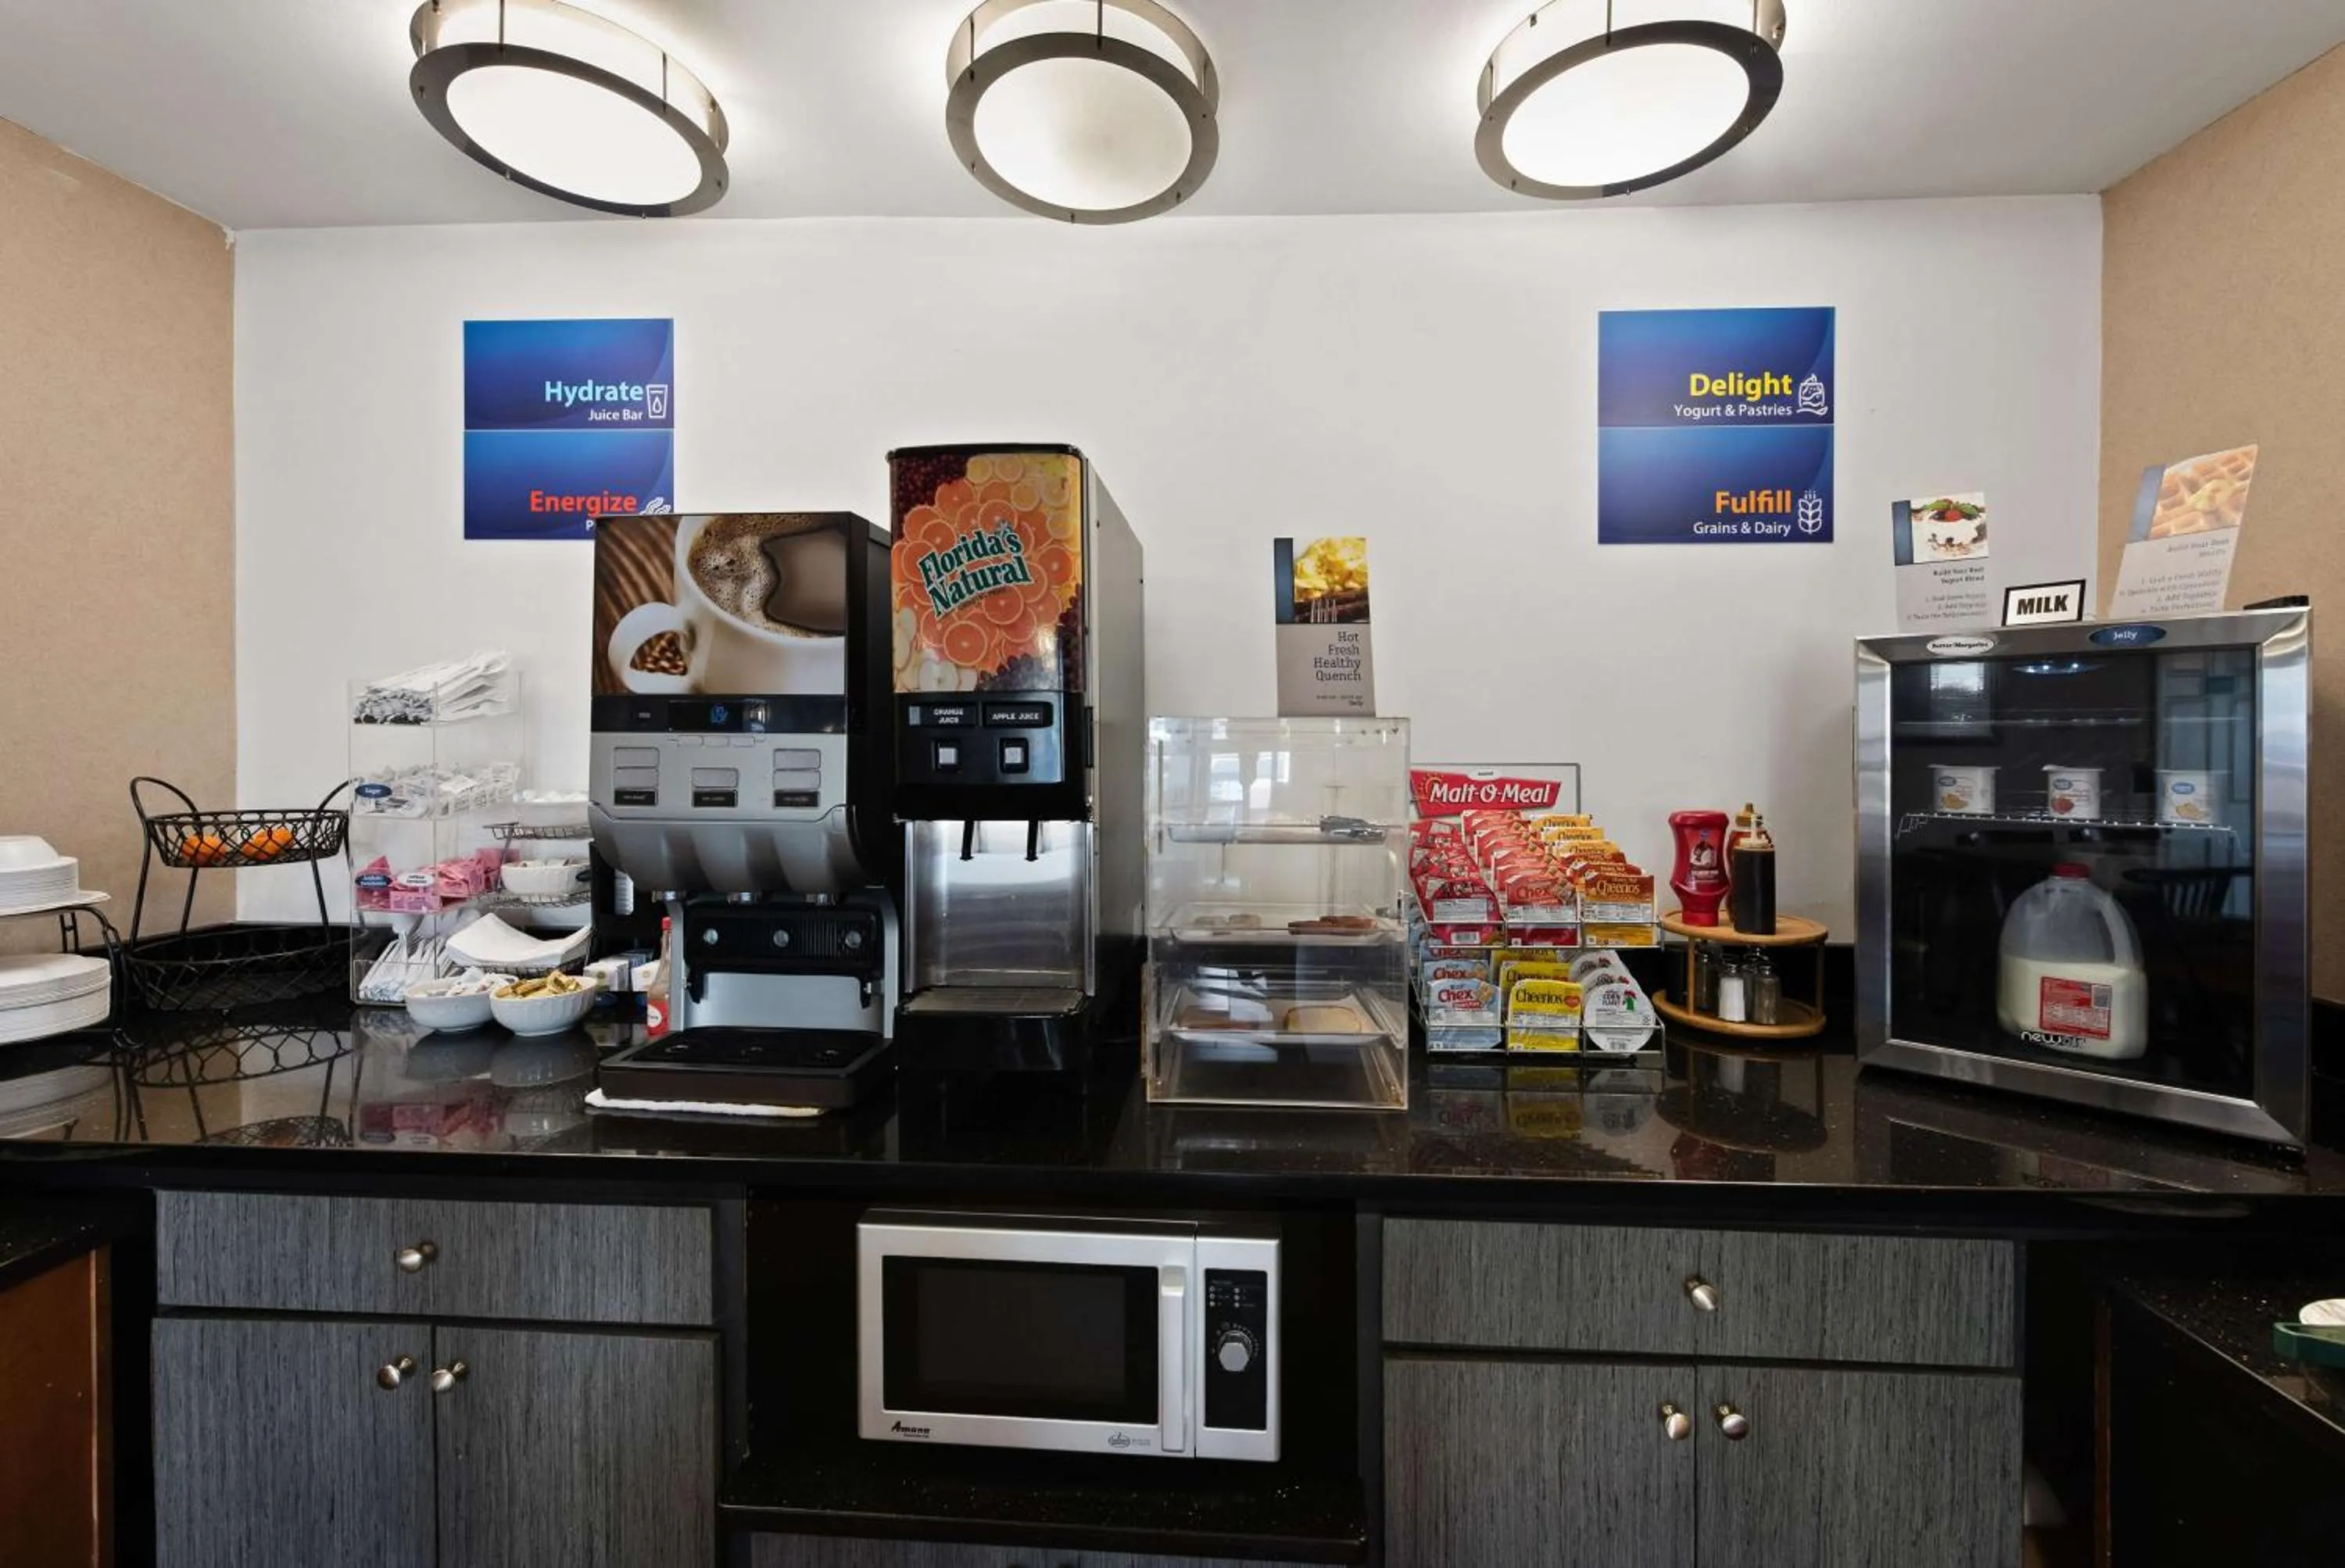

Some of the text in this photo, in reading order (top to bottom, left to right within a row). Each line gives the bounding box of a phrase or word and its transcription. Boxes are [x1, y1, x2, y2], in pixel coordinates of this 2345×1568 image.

[544, 379, 643, 407] Hydrate
[1690, 372, 1792, 401] Delight
[588, 409, 643, 421] Juice Bar
[1674, 403, 1792, 420] Yogurt & Pastries
[528, 490, 637, 517] Energize
[1715, 489, 1792, 514] Fulfill
[1693, 521, 1791, 536] Grains & Dairy
[918, 524, 1022, 586] Florida's
[929, 556, 1032, 616] Natural
[2016, 594, 2069, 615] MILK
[1337, 632, 1359, 643] Hot
[2113, 631, 2138, 640] Jelly
[1328, 644, 1360, 655] Fresh
[1313, 657, 1361, 674] Healthy
[1316, 670, 1362, 682] Quench
[1429, 782, 1551, 804] Malt-O-Meal
[1597, 880, 1641, 895] Cheerios
[1437, 989, 1474, 1003] Chex
[1516, 988, 1563, 1004] Cheerios
[891, 1420, 931, 1434] Amana
